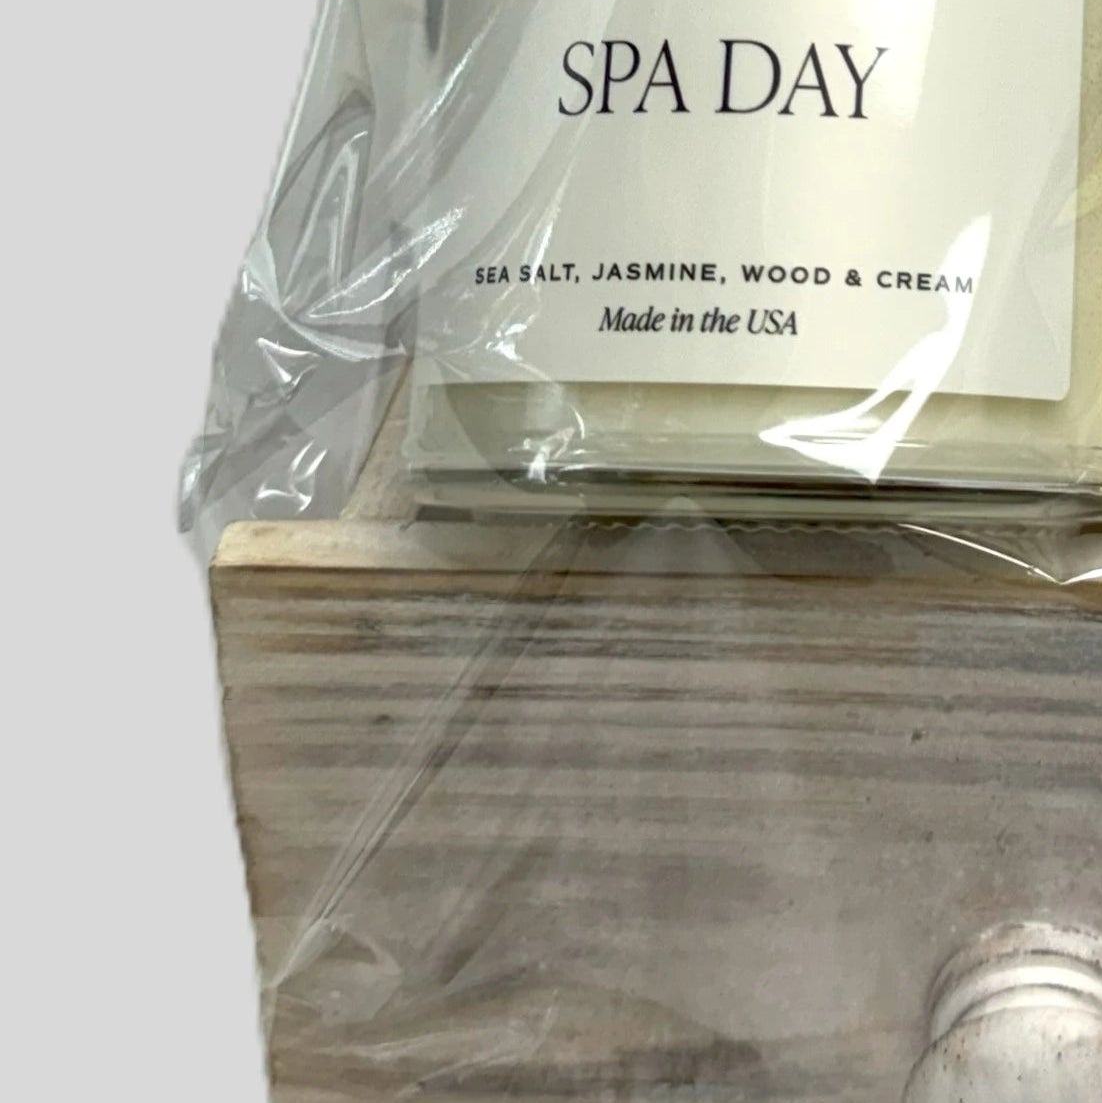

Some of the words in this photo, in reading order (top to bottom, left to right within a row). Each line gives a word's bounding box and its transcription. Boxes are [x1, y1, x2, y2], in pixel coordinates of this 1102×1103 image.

[558, 39, 690, 116] SPA
[714, 39, 889, 119] DAY
[475, 264, 510, 285] SEA
[519, 263, 580, 285] SALT,
[592, 262, 727, 286] JASMINE,
[741, 264, 831, 285] WOOD
[844, 267, 863, 287] &
[876, 271, 973, 295] CREAM
[599, 307, 666, 333] Made
[669, 309, 695, 333] in
[700, 308, 740, 334] the
[746, 310, 799, 336] USA
